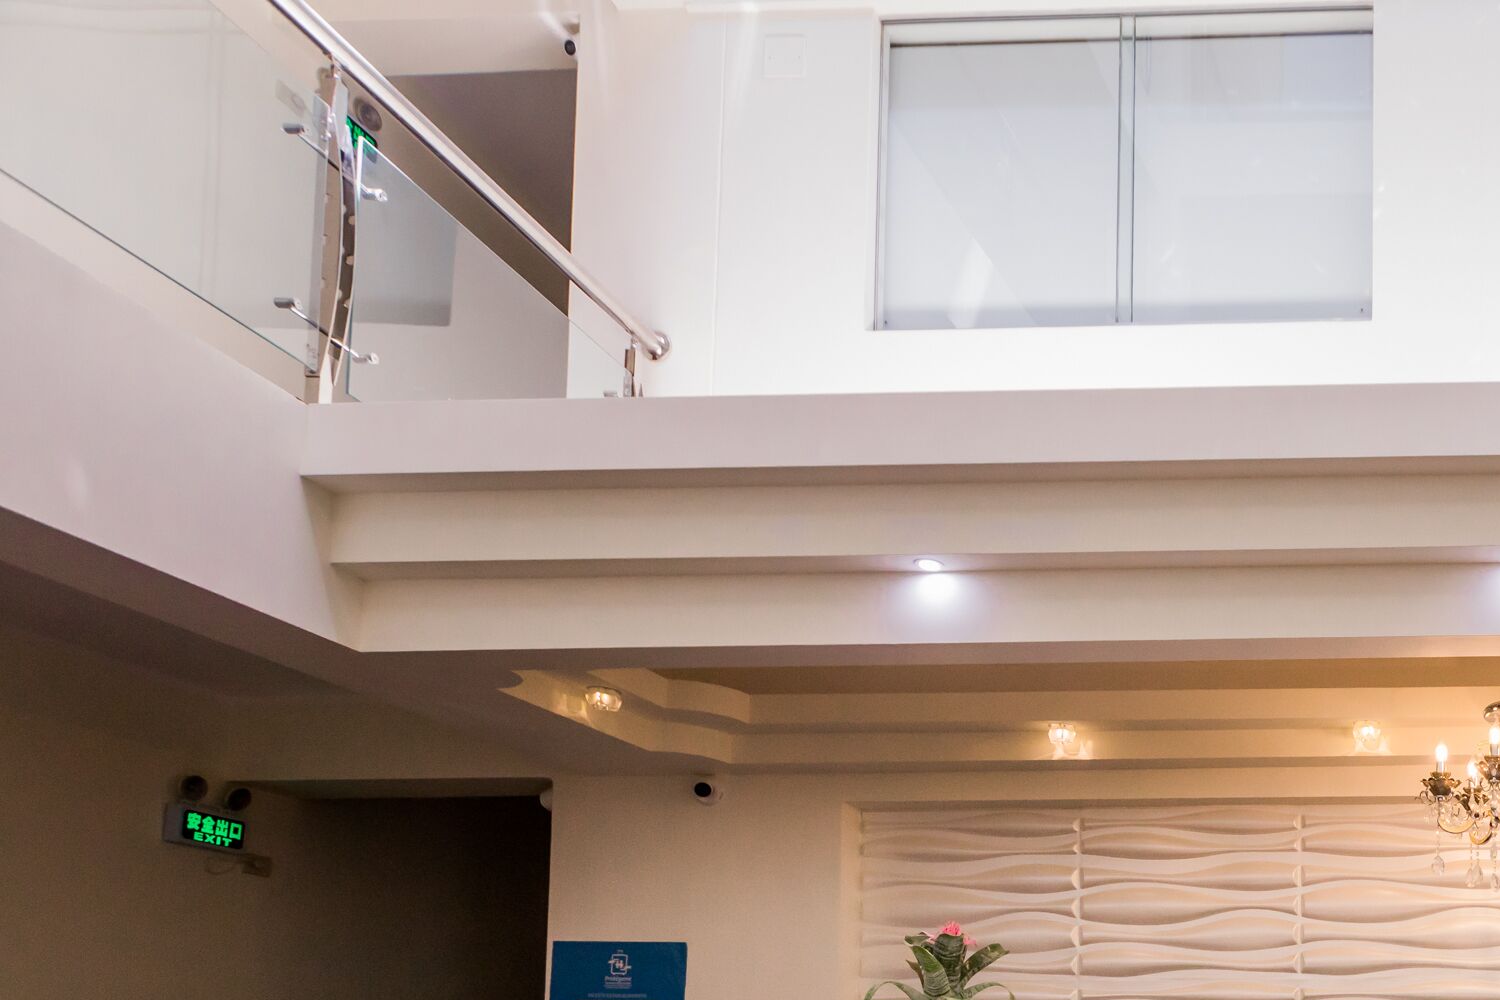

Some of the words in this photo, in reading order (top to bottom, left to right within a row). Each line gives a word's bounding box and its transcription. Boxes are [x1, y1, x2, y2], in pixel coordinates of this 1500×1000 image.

[187, 813, 243, 841] 安全出口
[193, 831, 233, 847] EXIT
